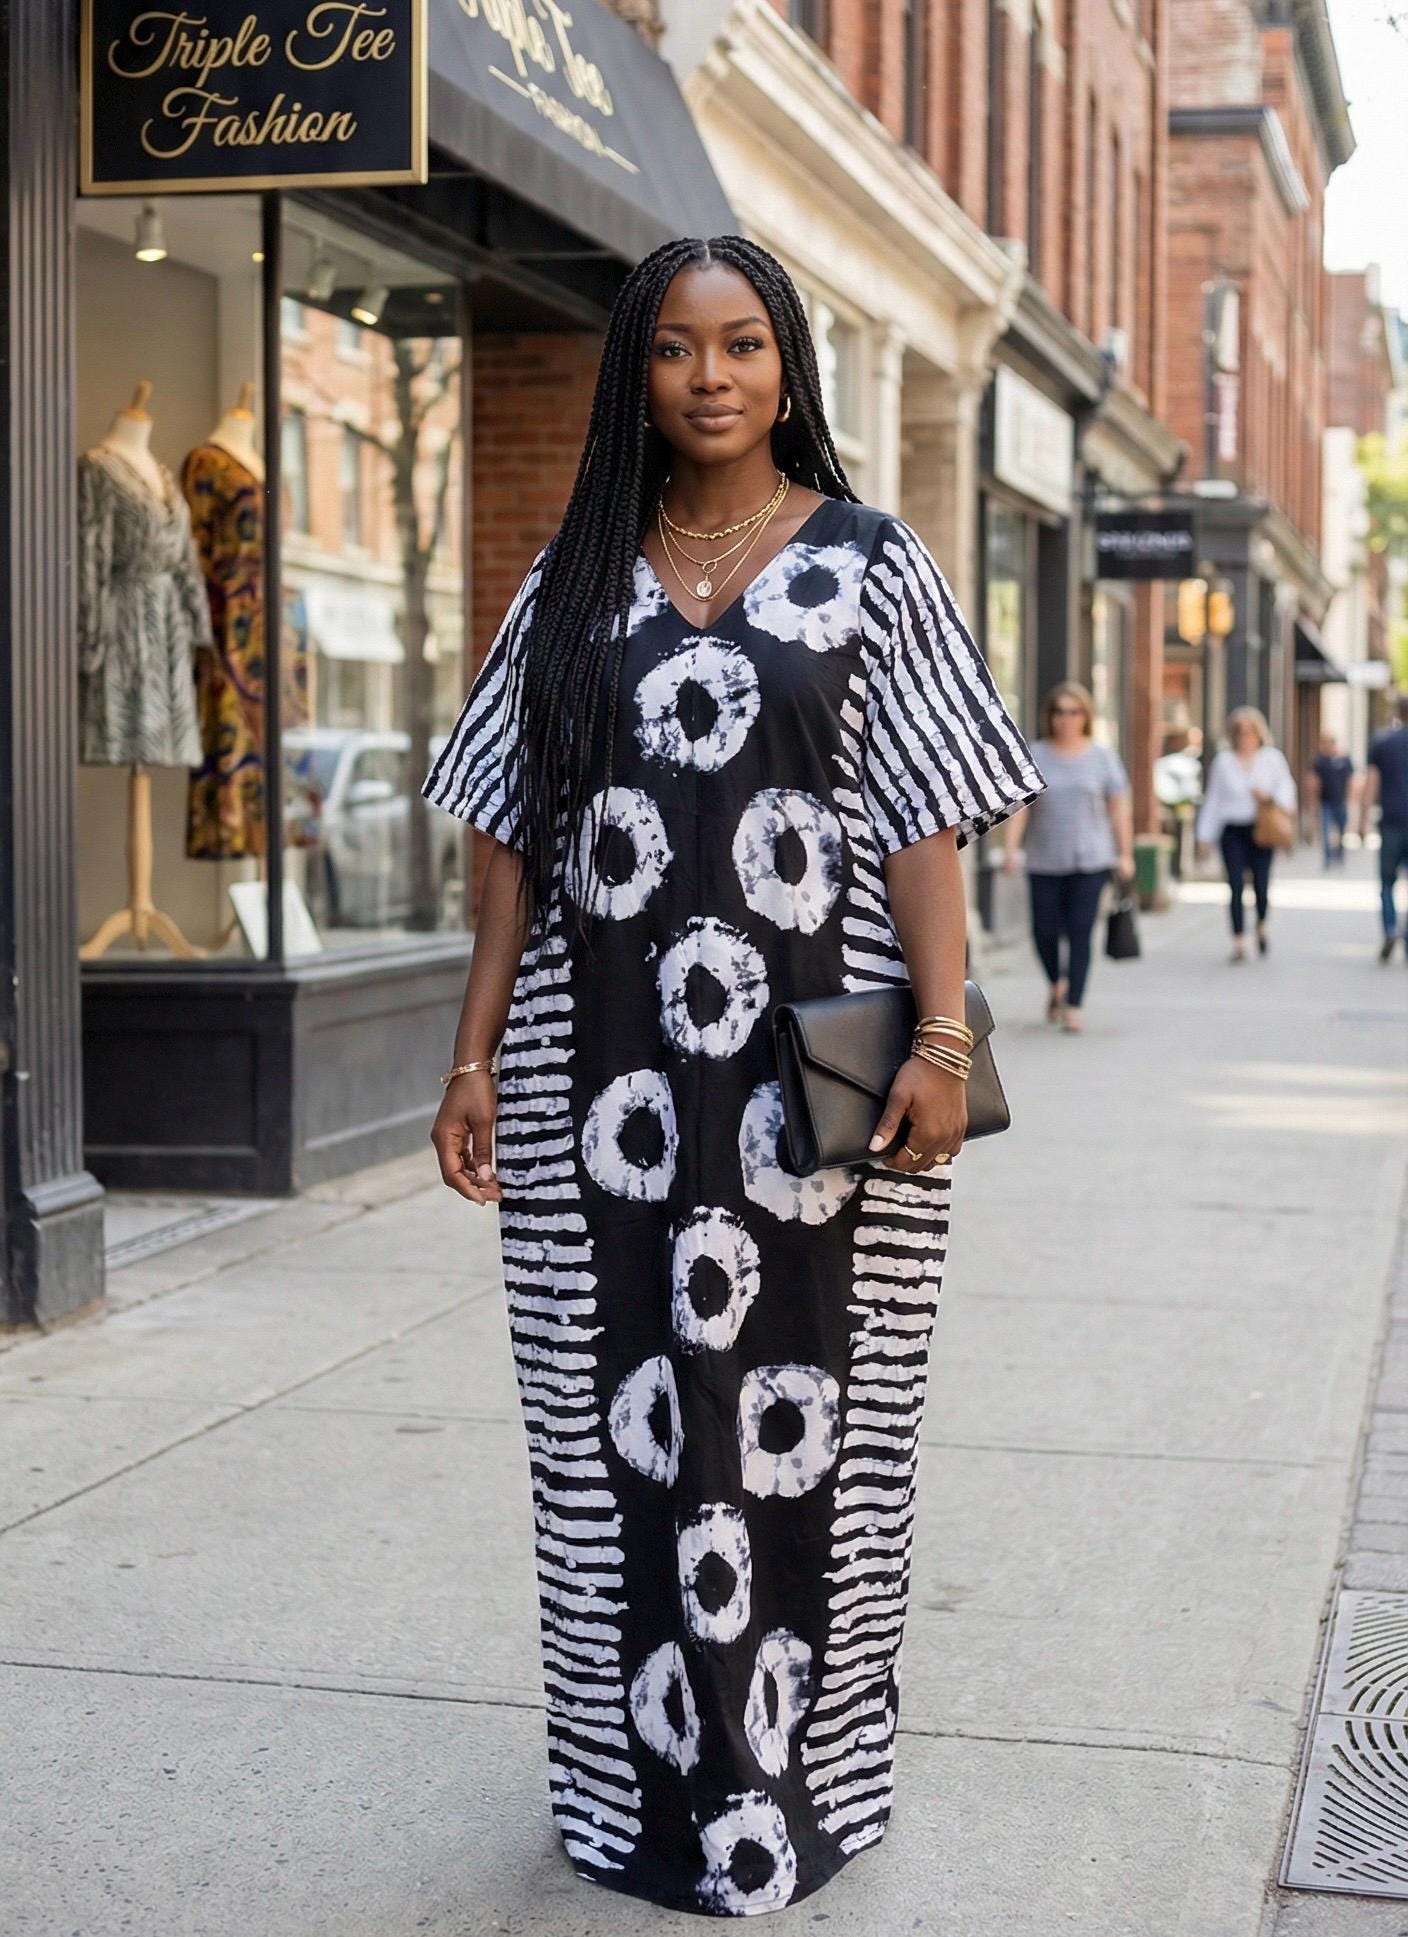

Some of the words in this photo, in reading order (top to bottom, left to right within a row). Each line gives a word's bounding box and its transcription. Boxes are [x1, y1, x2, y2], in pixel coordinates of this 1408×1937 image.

[108, 11, 272, 88] Triple
[285, 2, 396, 70] Tee
[141, 87, 357, 158] Fashion
